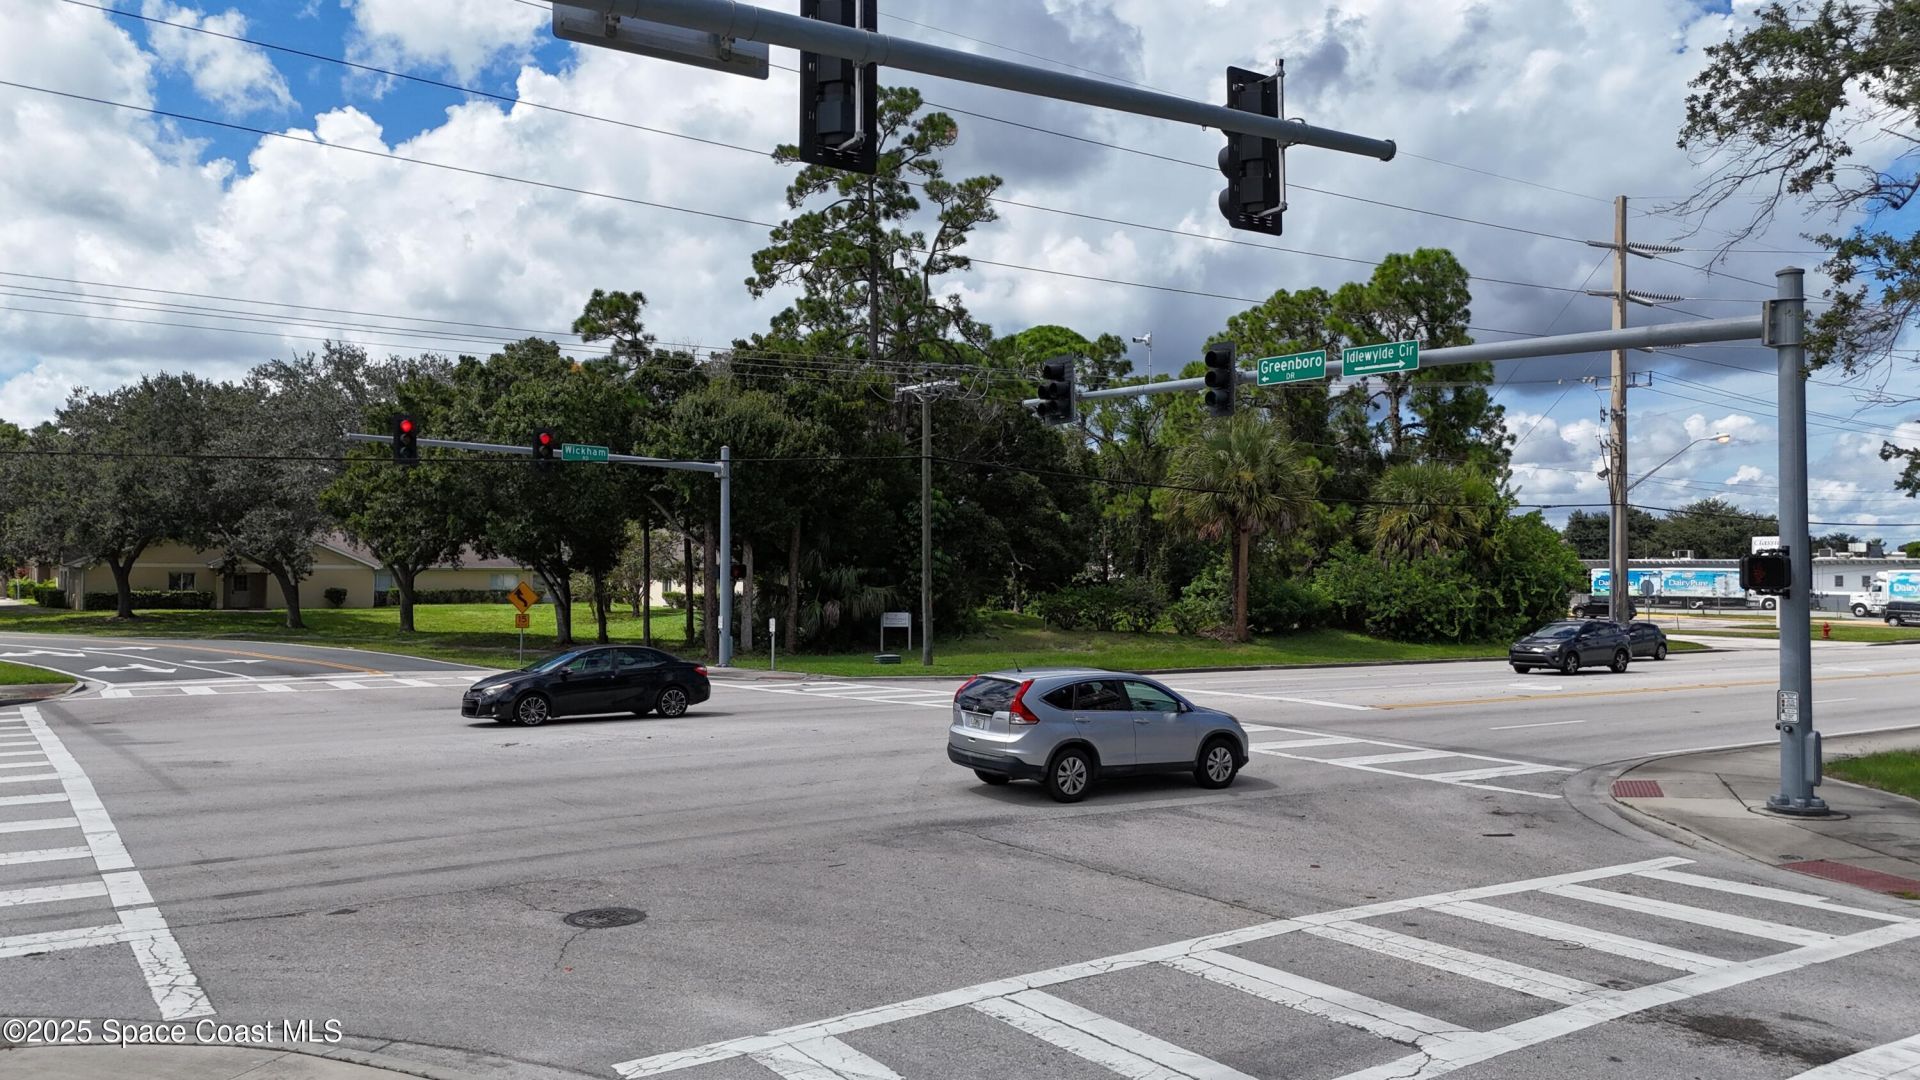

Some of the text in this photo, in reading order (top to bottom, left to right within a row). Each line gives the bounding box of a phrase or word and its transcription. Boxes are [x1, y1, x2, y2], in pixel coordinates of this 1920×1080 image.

[1346, 344, 1415, 363] Idlewylde Cir
[1261, 356, 1322, 374] Greenboro
[1285, 372, 1296, 380] DR
[565, 446, 605, 456] Wickham
[1668, 579, 1709, 587] DairyPure
